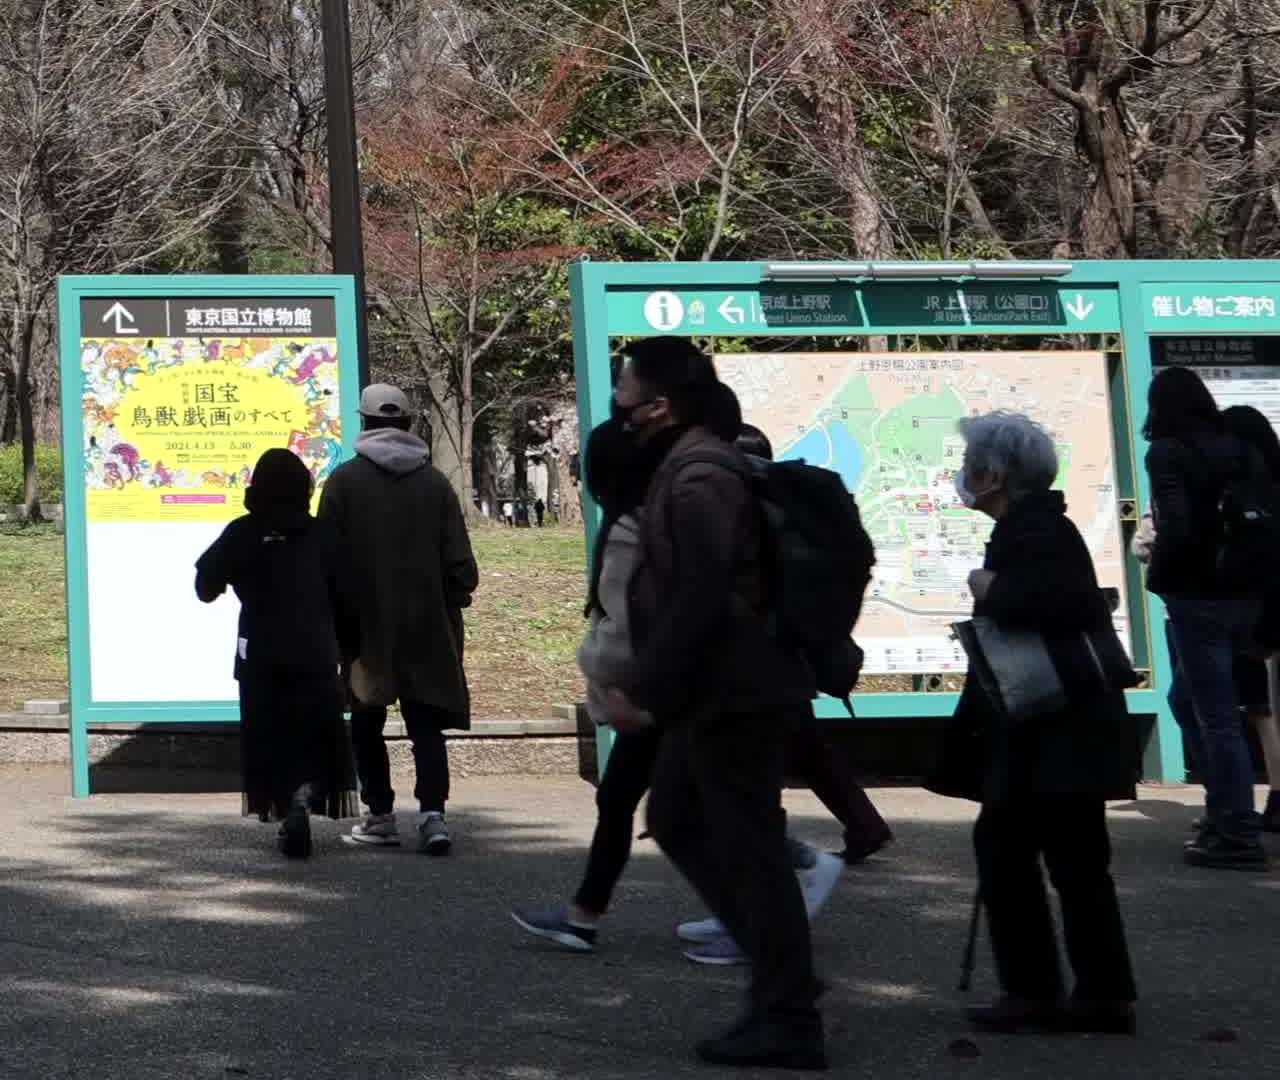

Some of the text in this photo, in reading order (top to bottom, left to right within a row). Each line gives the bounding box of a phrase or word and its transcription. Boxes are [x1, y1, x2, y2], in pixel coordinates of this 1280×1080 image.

[184, 307, 313, 326] 東京国立博物館
[813, 312, 848, 322] Station
[1151, 295, 1276, 318] 催し物ご案内
[195, 382, 241, 404] 国宝
[130, 404, 294, 429] 鳥獣戯画のすべて
